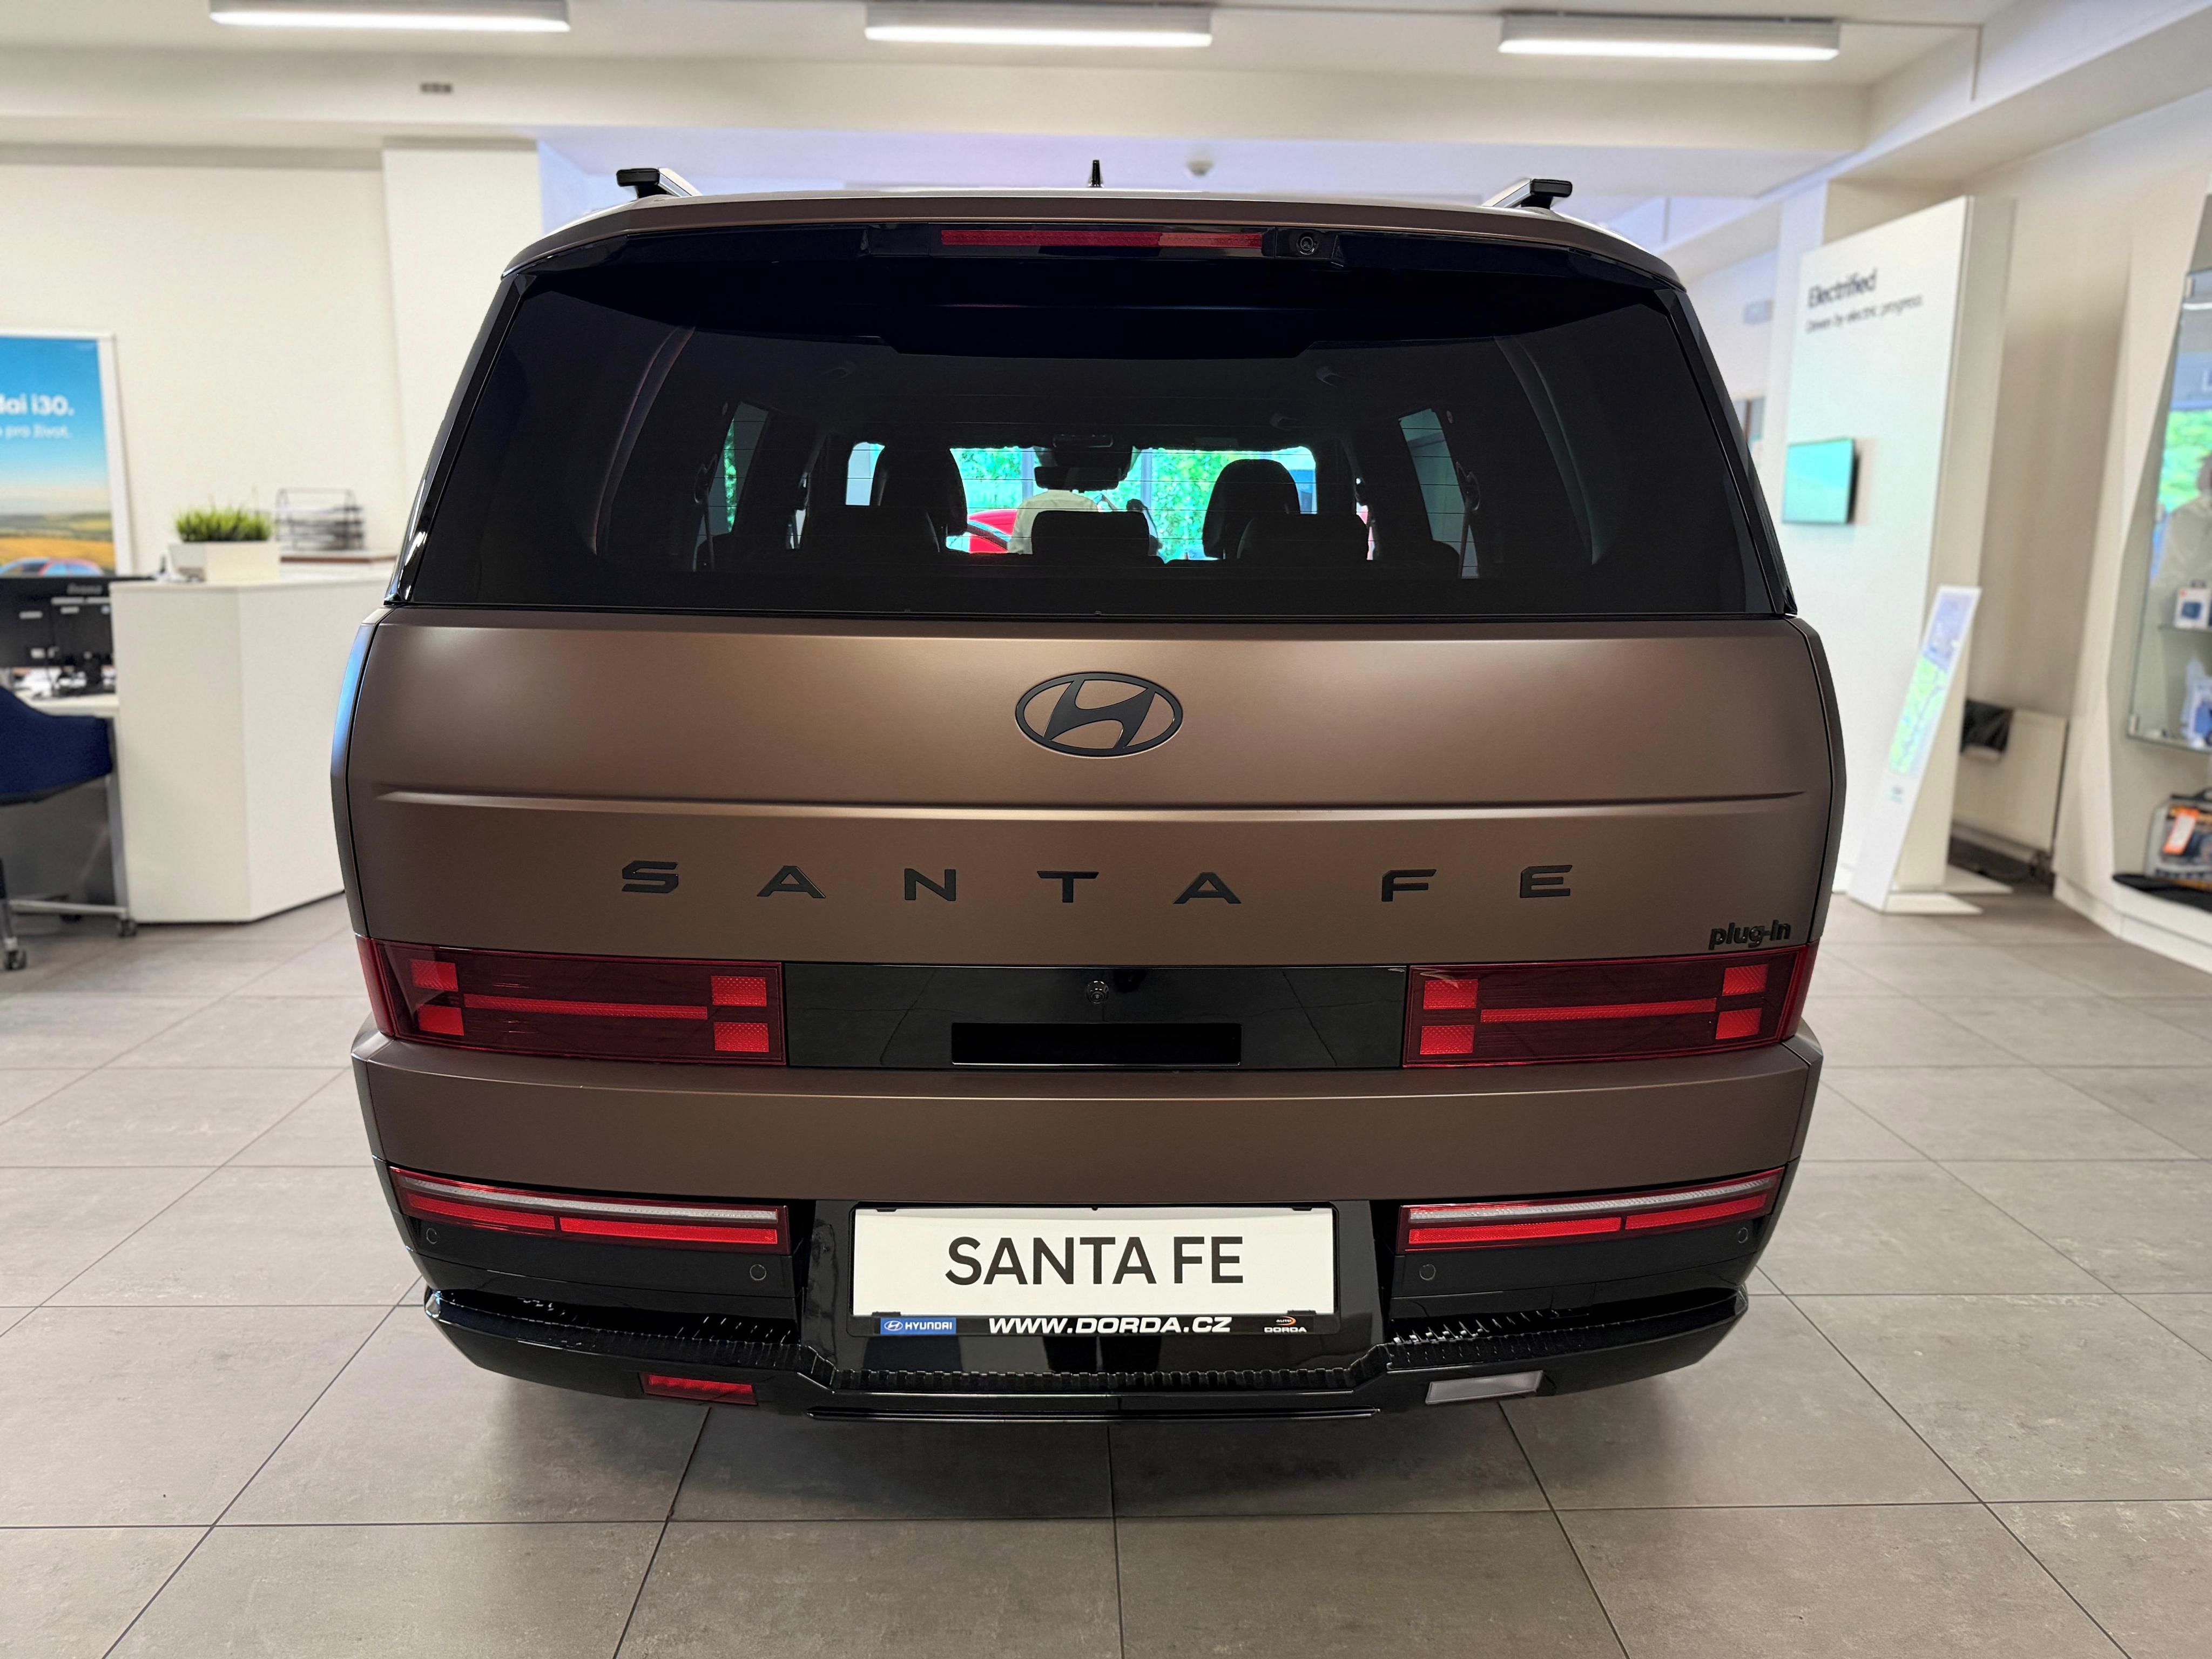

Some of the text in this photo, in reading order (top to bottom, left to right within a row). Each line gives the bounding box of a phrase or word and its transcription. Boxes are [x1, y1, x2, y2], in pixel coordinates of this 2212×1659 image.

[1808, 268, 1877, 308] Electrified
[31, 393, 75, 416] i30.
[622, 860, 1573, 905] SANTA FE
[1709, 920, 1791, 950] plug-in
[945, 1236, 1243, 1285] SANTA FE
[905, 1321, 953, 1330] HYUNDAI
[989, 1317, 1232, 1334] WWW.DORDA.CZ
